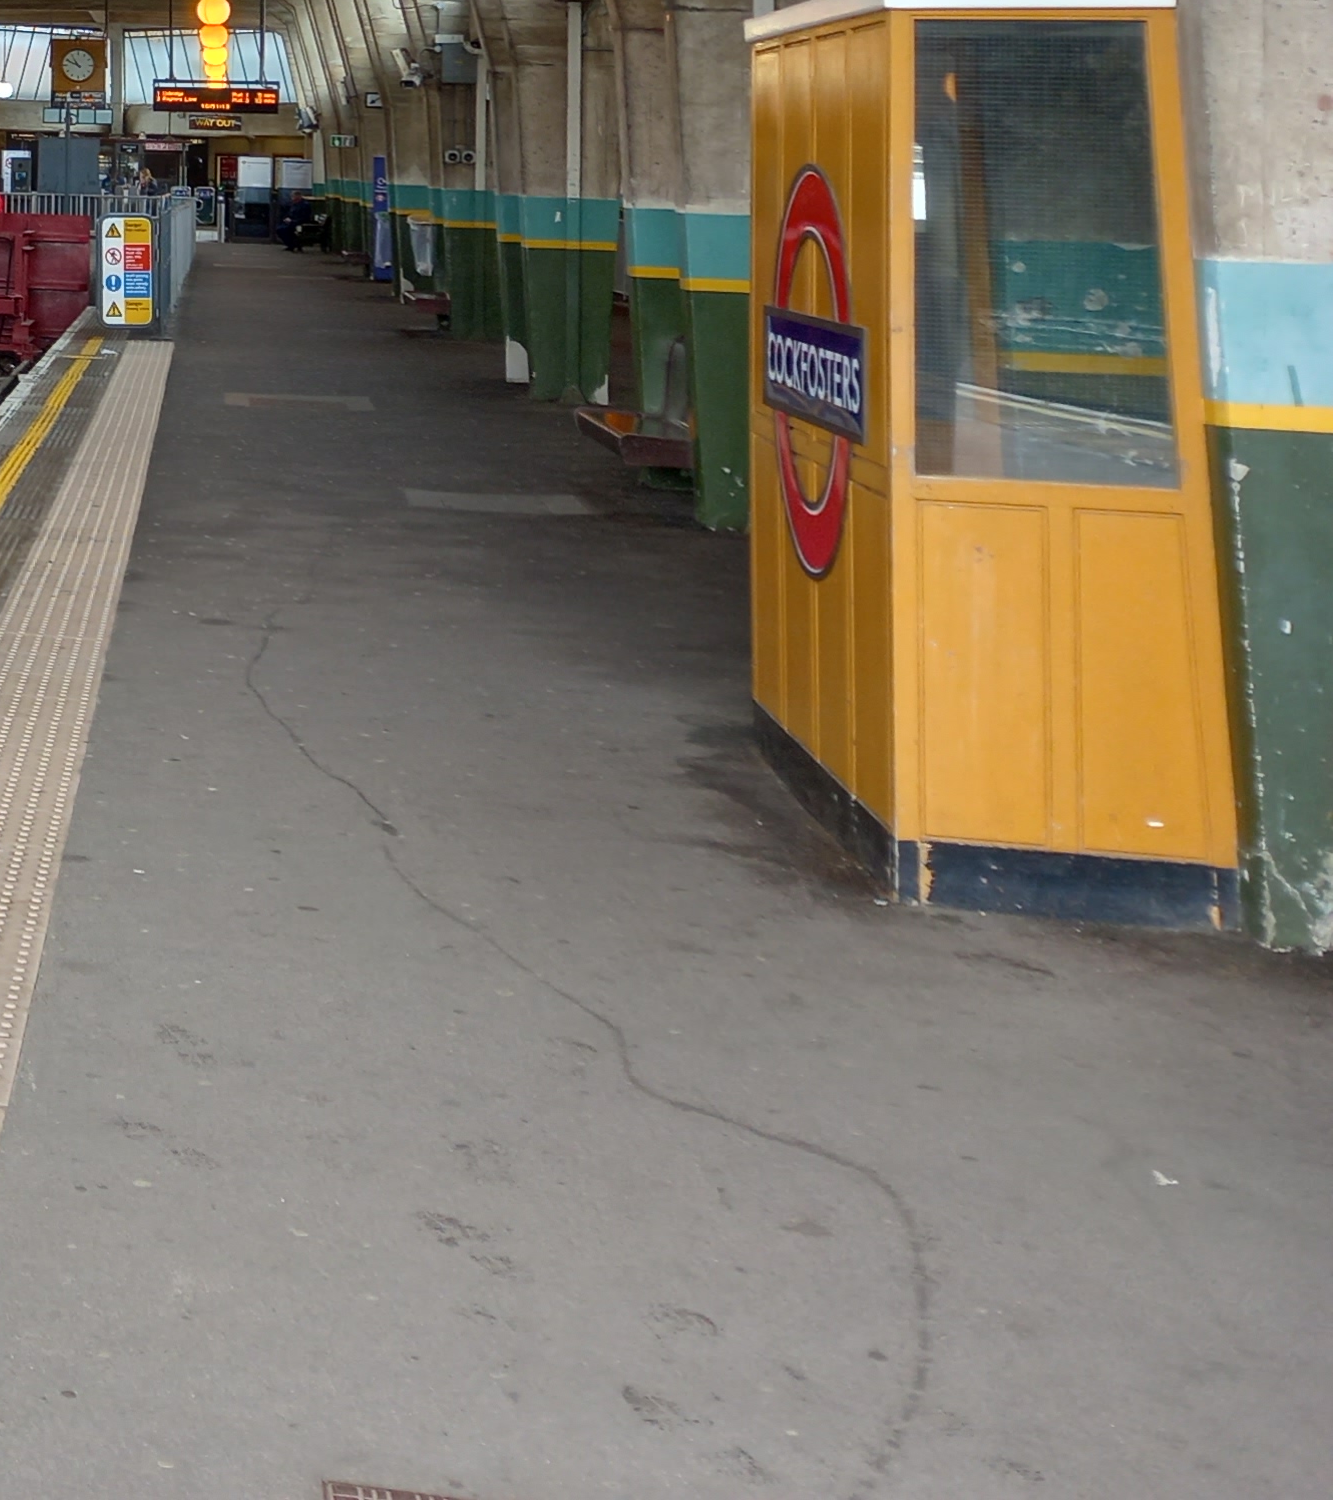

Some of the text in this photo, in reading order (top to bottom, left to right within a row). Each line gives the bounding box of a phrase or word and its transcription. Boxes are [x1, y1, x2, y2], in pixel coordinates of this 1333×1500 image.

[195, 118, 237, 127] WAY OUT
[767, 331, 861, 414] COCKFOSTERS
